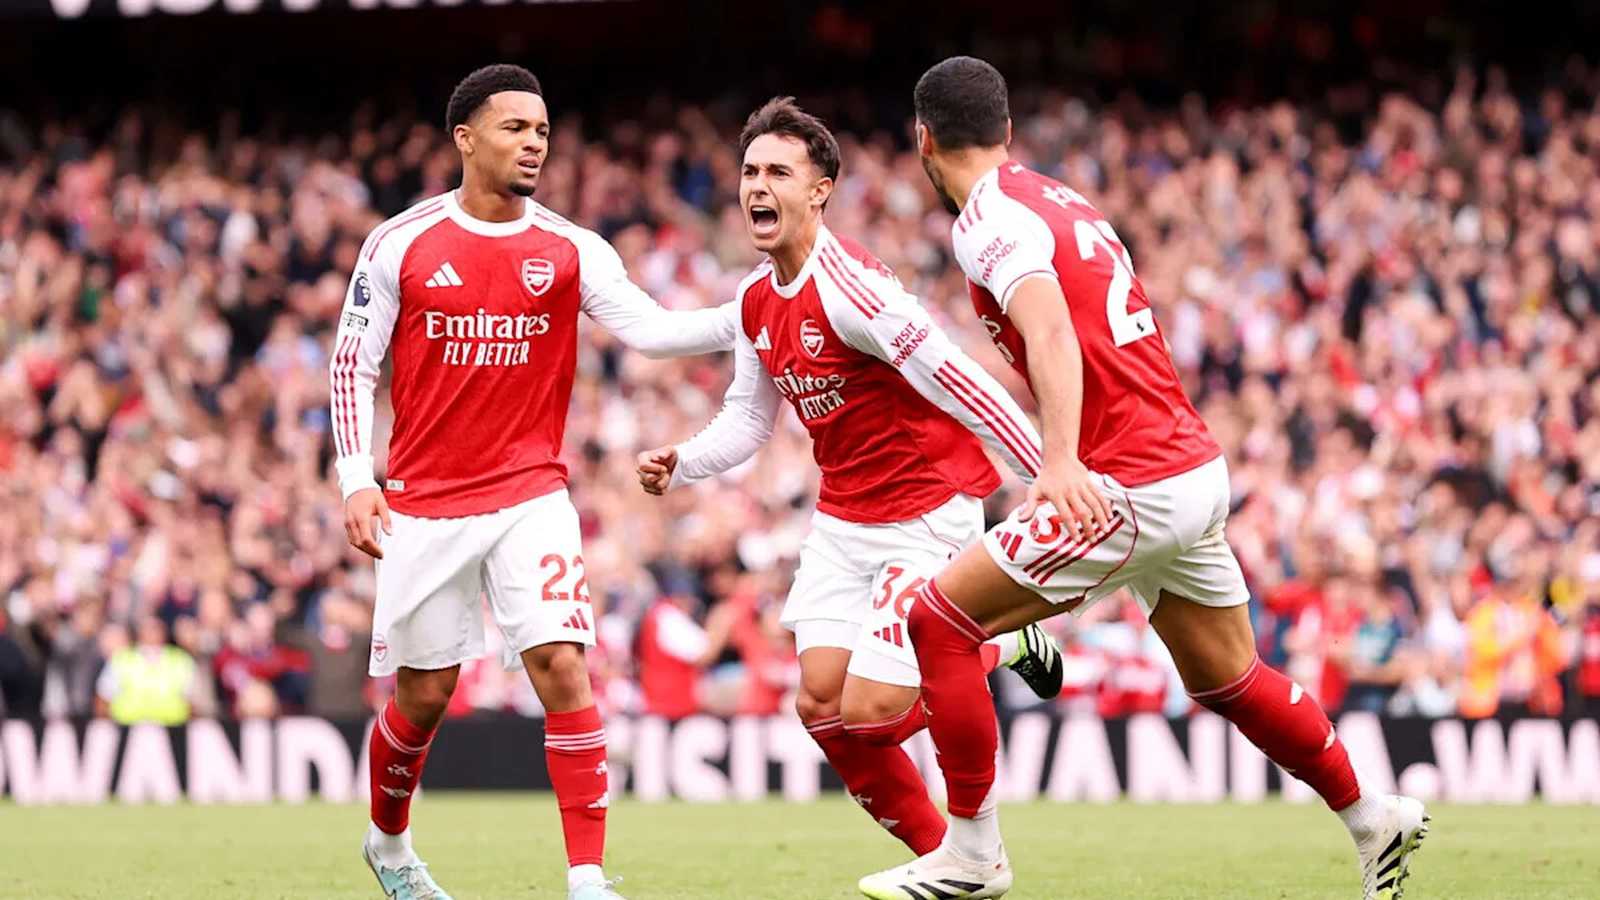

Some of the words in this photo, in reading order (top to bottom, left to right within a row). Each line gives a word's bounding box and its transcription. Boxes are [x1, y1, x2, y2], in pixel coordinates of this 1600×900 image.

[976, 236, 1003, 263] VISIT
[424, 308, 550, 339] Emirates
[890, 321, 916, 348] VISIT
[443, 341, 469, 365] FLY
[474, 341, 530, 367] BETTER
[892, 323, 928, 368] RWAND
[873, 566, 926, 620] 36
[0, 717, 423, 804] WAND
